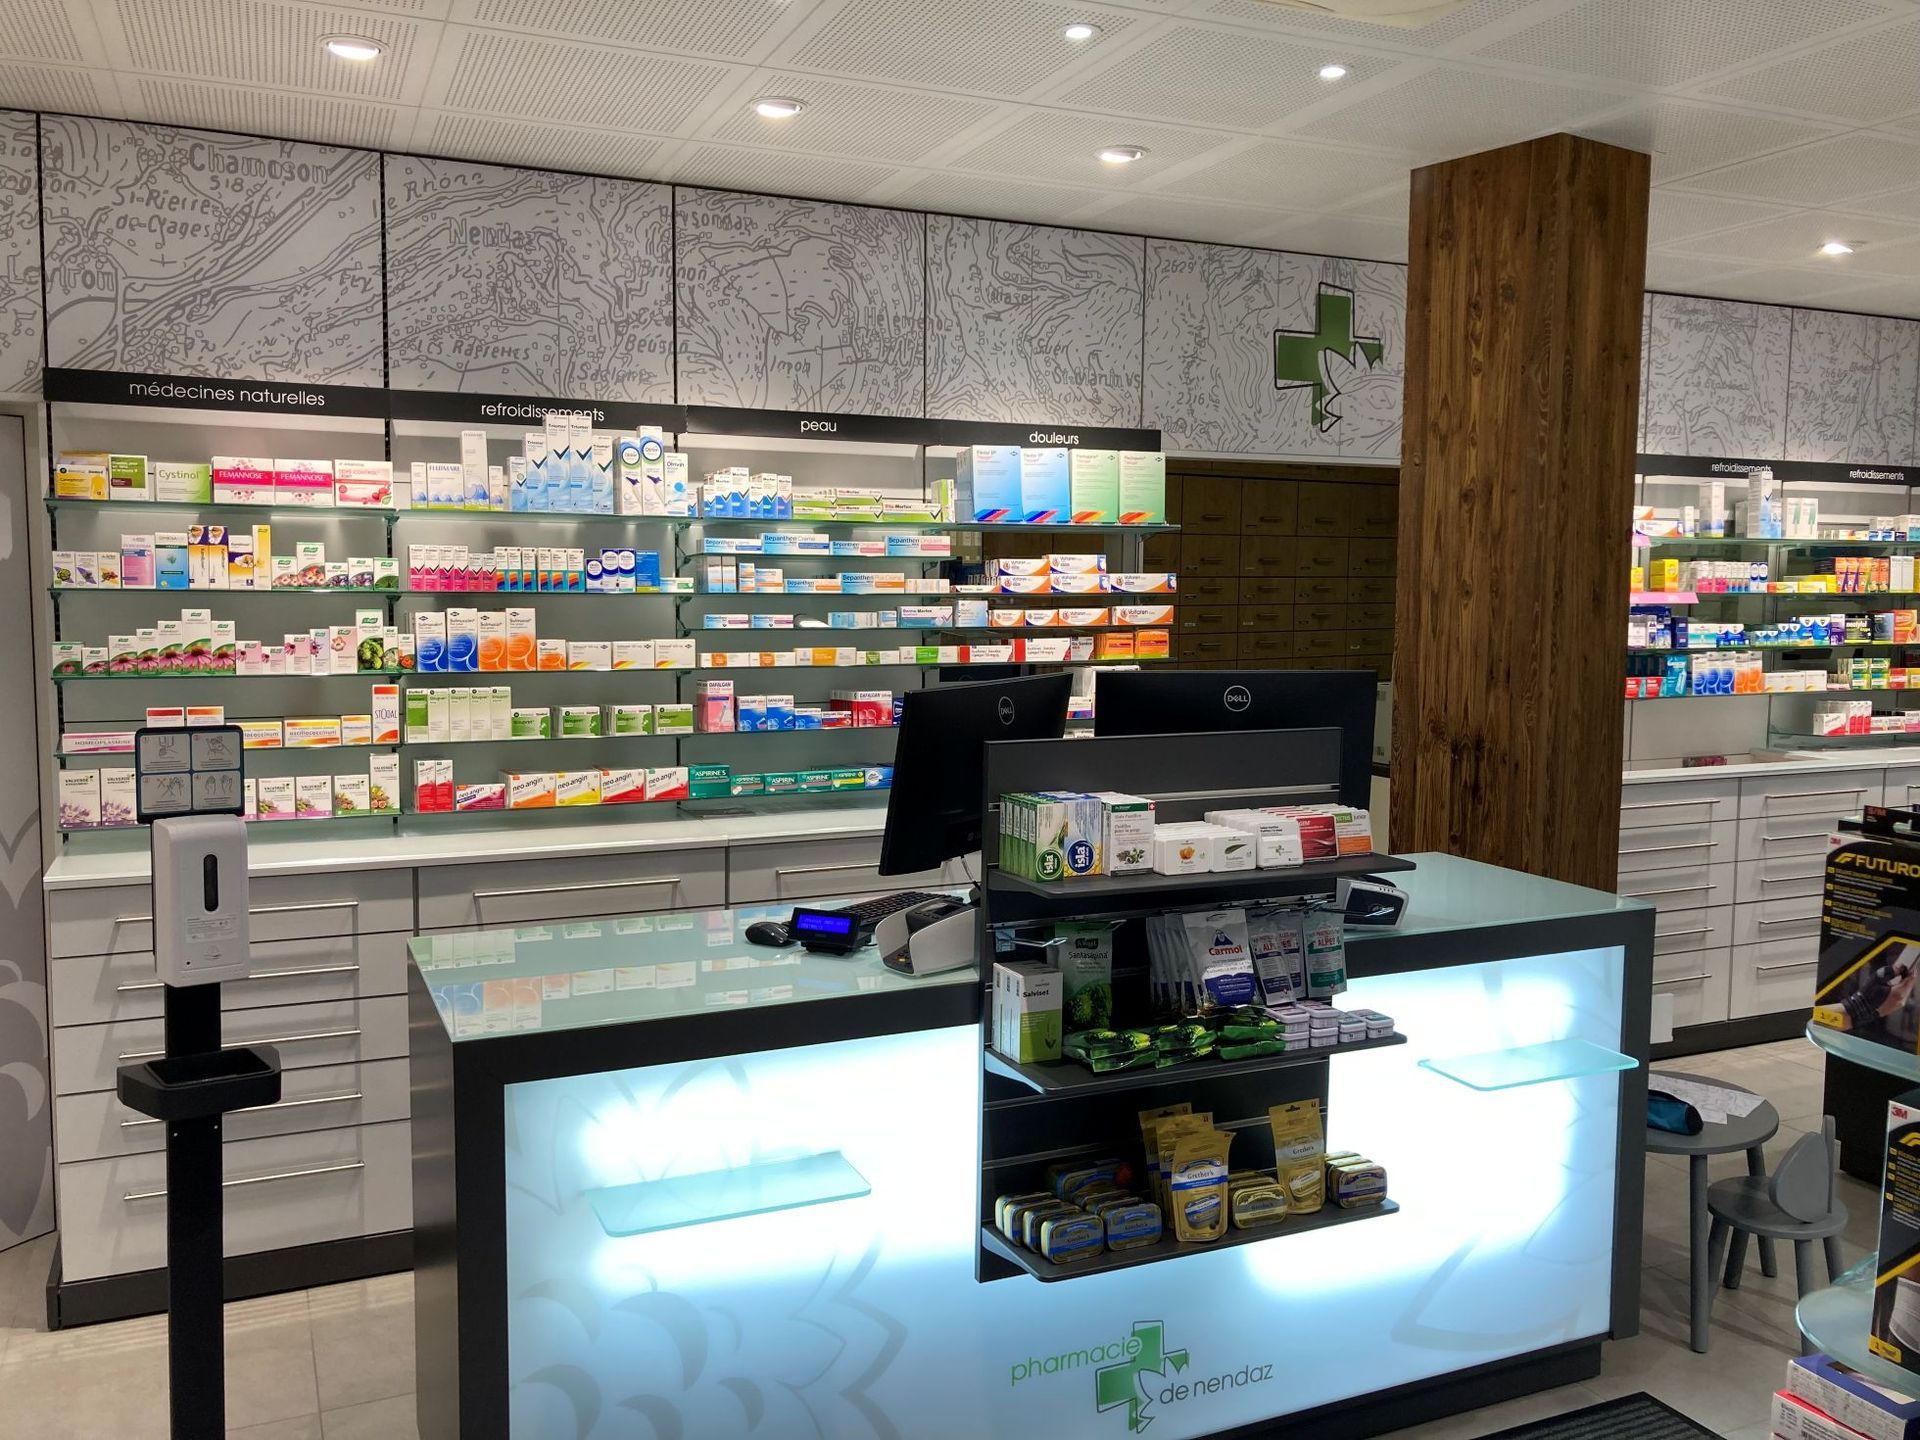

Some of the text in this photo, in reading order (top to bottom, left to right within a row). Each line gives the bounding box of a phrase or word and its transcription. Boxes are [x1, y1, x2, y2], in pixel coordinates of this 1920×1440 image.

[129, 381, 325, 406] médecines naturelles
[481, 403, 605, 422] refroidissements
[800, 419, 837, 433] peau
[1029, 431, 1080, 445] douleurs
[158, 469, 200, 480] Cystinol
[218, 470, 264, 480] FEMANNOSE
[280, 473, 326, 482] FEMANNOSE
[1849, 469, 1905, 481] refroidissements
[374, 706, 398, 721] STODAL
[1044, 853, 1054, 875] isla
[1074, 846, 1086, 869] isla
[1855, 854, 1920, 878] FUTURO
[1208, 944, 1244, 957] Carmol
[1022, 988, 1050, 998] Salviset
[1187, 1169, 1215, 1180] Grether's
[1011, 1335, 1143, 1387] pharmacie
[1159, 1363, 1274, 1404] de nendaz
